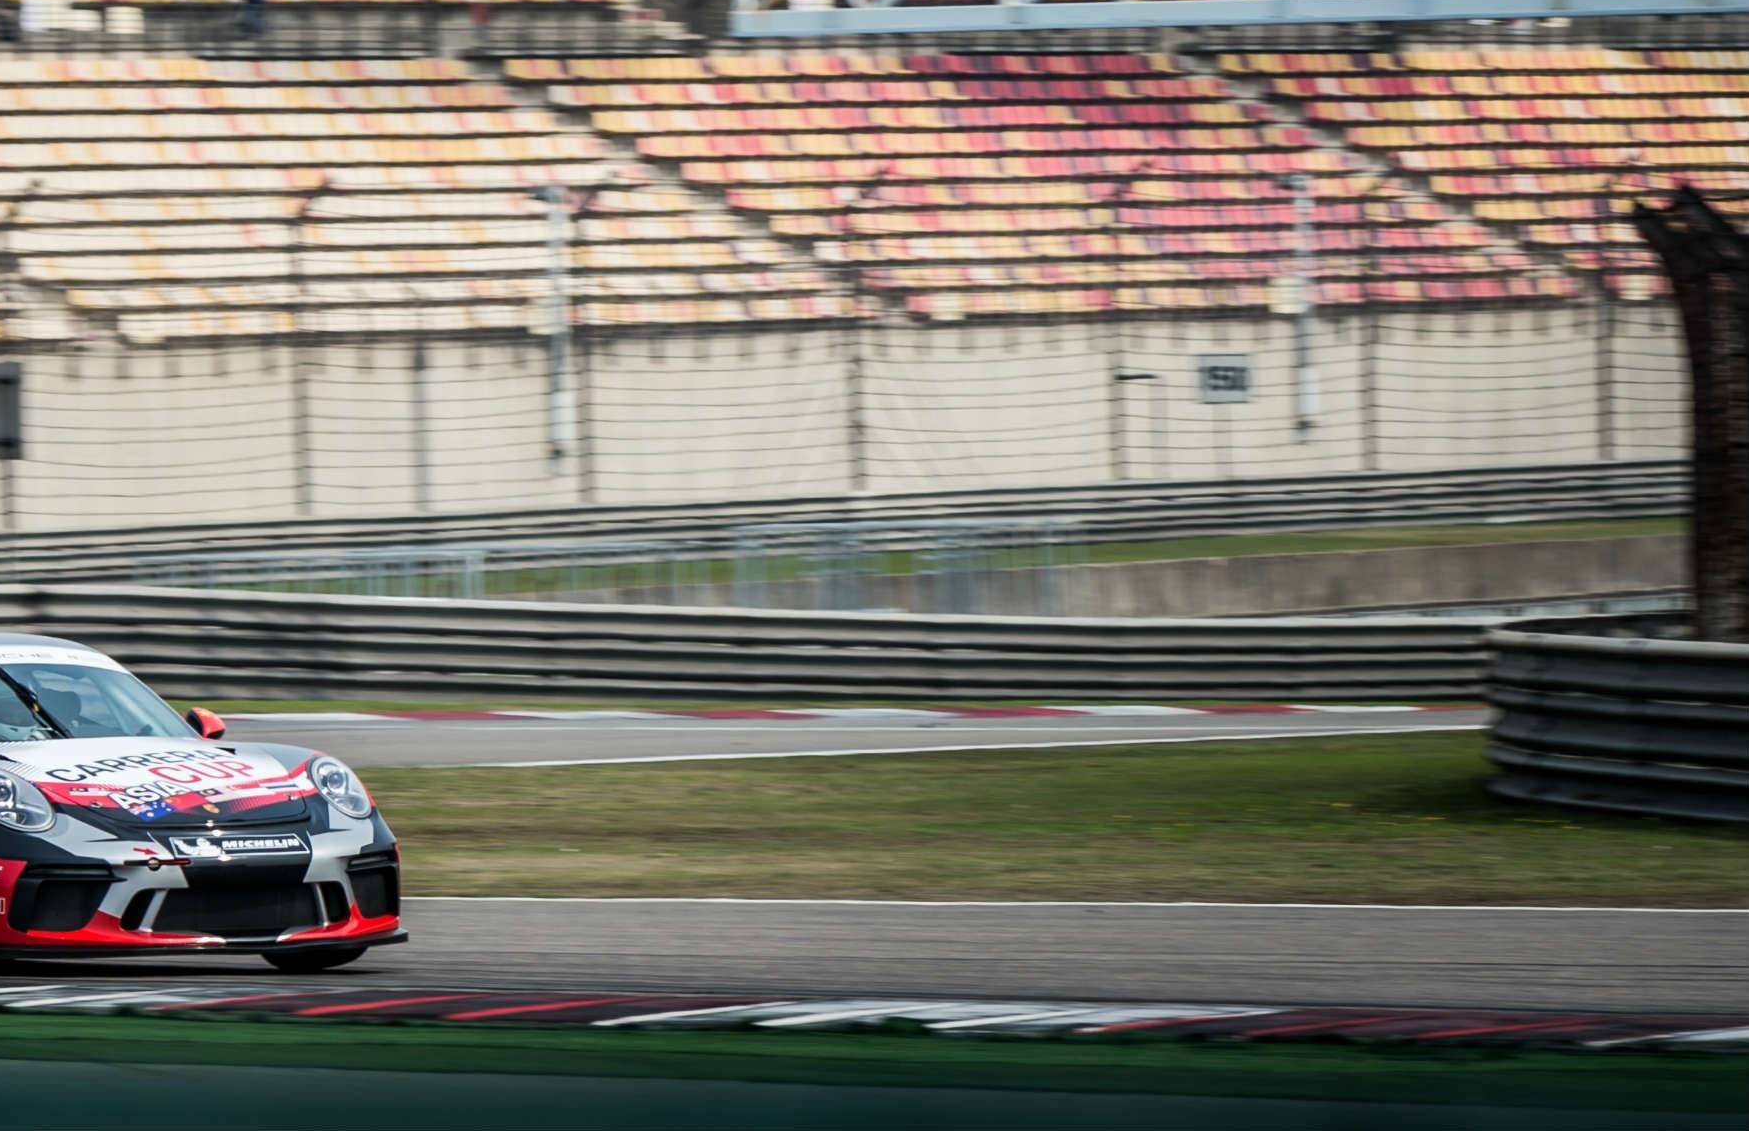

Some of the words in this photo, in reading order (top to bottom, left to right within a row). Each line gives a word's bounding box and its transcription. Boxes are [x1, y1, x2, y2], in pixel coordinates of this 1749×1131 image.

[46, 746, 226, 784] CARRERA
[147, 760, 254, 785] CUP
[107, 779, 189, 811] ASIA
[222, 839, 300, 849] MICHELIN
